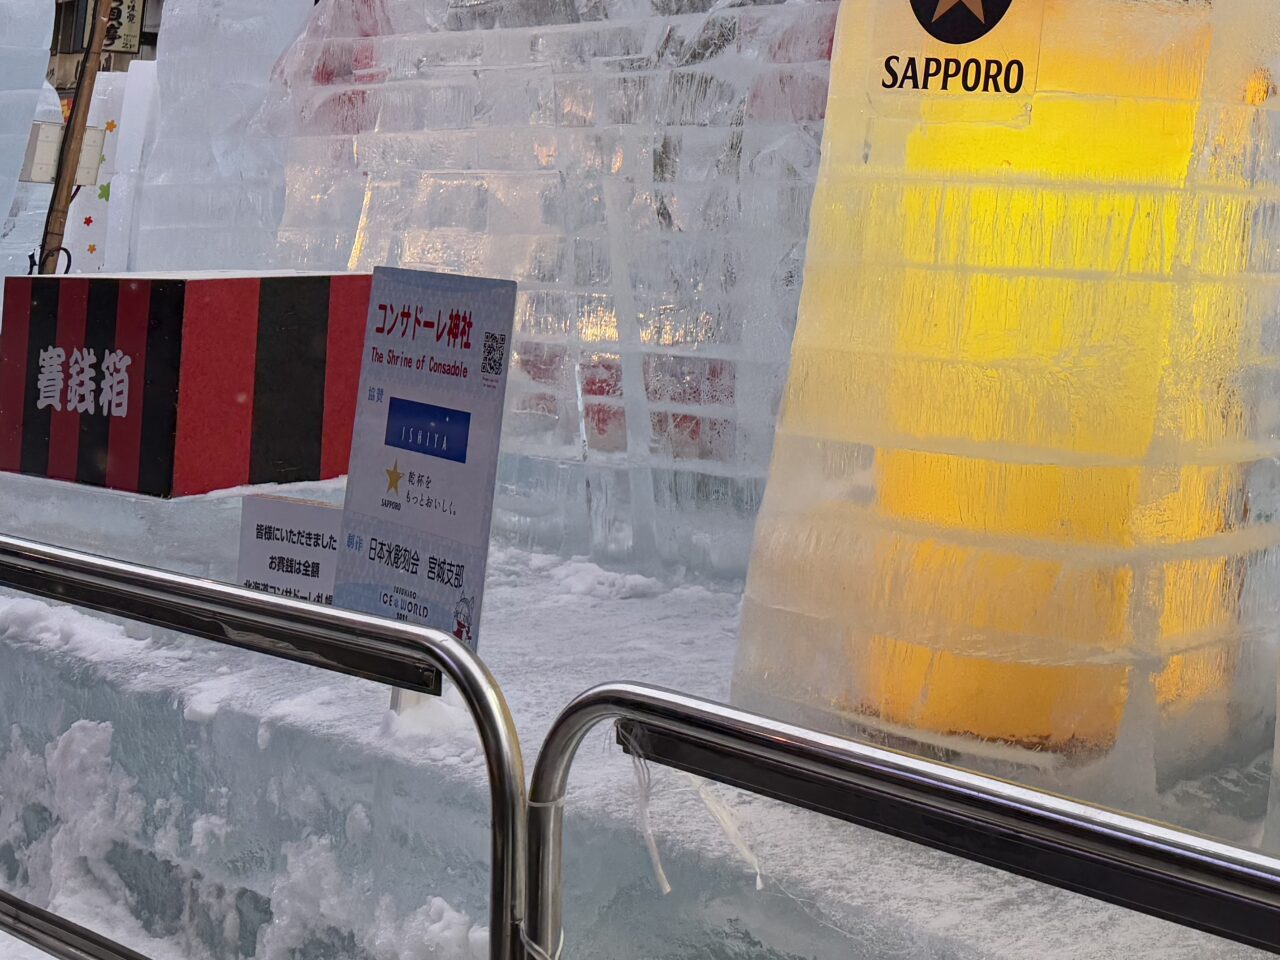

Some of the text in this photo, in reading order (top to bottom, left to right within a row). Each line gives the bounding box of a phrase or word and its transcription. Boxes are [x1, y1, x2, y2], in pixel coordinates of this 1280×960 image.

[882, 55, 1025, 94] SAPPORO
[375, 303, 474, 350] コンサドーレ神社
[371, 346, 384, 363] The
[386, 348, 413, 369] Shrine
[415, 355, 426, 371] of
[401, 425, 448, 452] ISHIYA
[381, 498, 402, 512] SAPPORO
[255, 523, 338, 551] 皆様にいただきました
